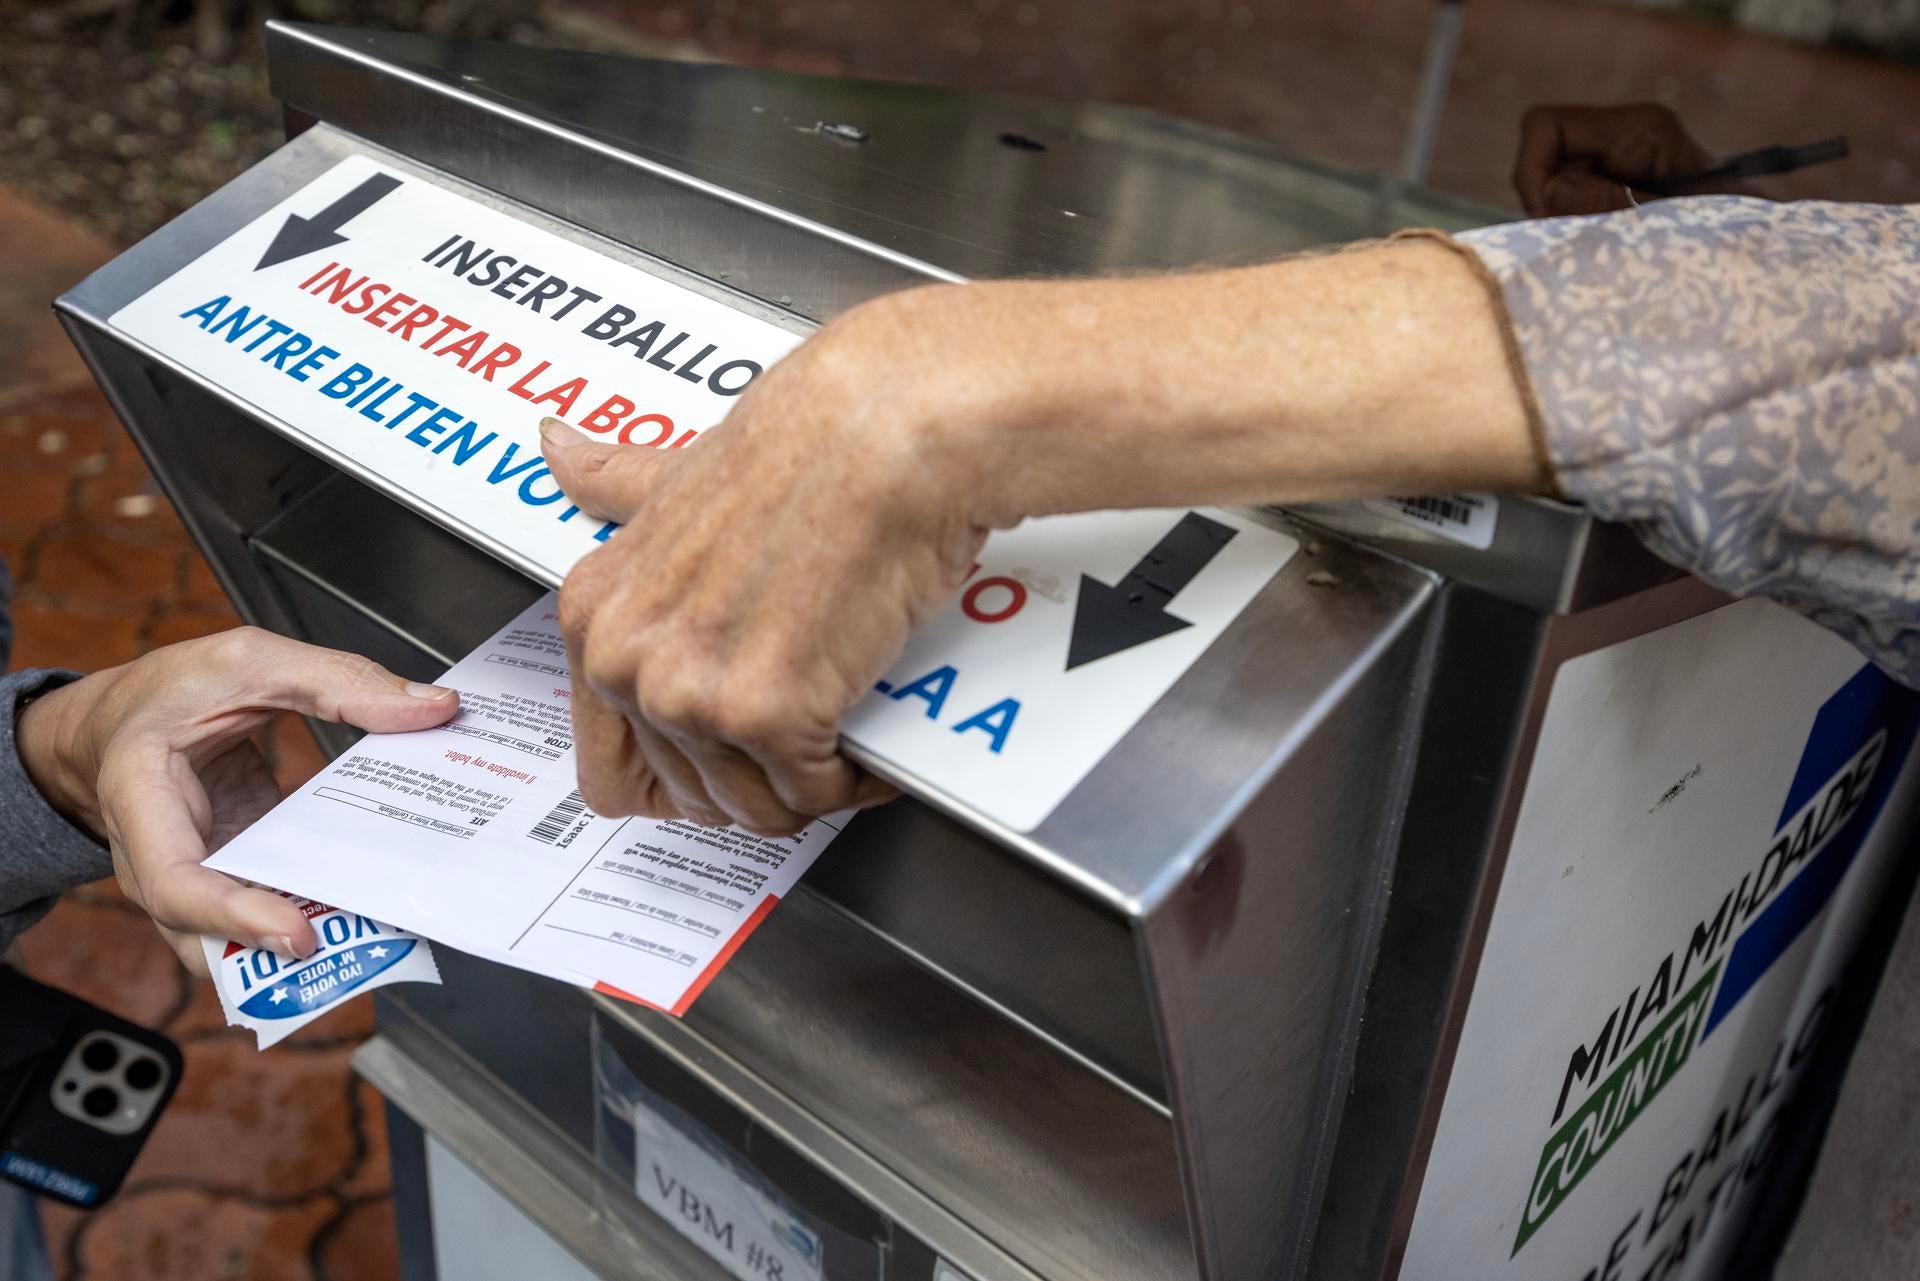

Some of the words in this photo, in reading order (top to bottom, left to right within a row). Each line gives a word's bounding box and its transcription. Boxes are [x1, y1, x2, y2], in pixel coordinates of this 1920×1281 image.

[422, 233, 604, 323] INSERT
[596, 309, 766, 397] BALLO
[299, 261, 522, 383] INSERTAR
[508, 361, 590, 419] LA
[957, 562, 1027, 624] O
[180, 294, 343, 385] ANTRE
[319, 361, 499, 469] BILTEN
[873, 664, 959, 720] A
[951, 697, 1021, 755] A
[544, 737, 572, 750] ECTOR
[445, 750, 471, 765] ballot.
[471, 757, 487, 767] my
[487, 764, 528, 781] invalidate
[469, 817, 489, 826] ATE
[556, 820, 588, 849] Isaac
[656, 825, 683, 835] contacto
[719, 836, 740, 845] arriba
[729, 831, 762, 843] problema
[635, 843, 666, 855] signature
[761, 841, 791, 855] cualquier
[639, 852, 660, 862] above
[667, 851, 680, 859] any
[659, 859, 689, 871] supplied
[704, 864, 725, 874] notify
[690, 869, 729, 885] information
[730, 864, 768, 881] deficiencies.
[734, 875, 752, 883] used
[729, 882, 758, 895] Contact
[753, 881, 763, 889] be
[236, 914, 380, 991] VOD!
[299, 963, 336, 985] VOTE!
[301, 978, 338, 1003] VOTÉ!
[1527, 985, 1713, 1224] COUNTY
[653, 1164, 734, 1250] VBM
[746, 1241, 784, 1281] #8
